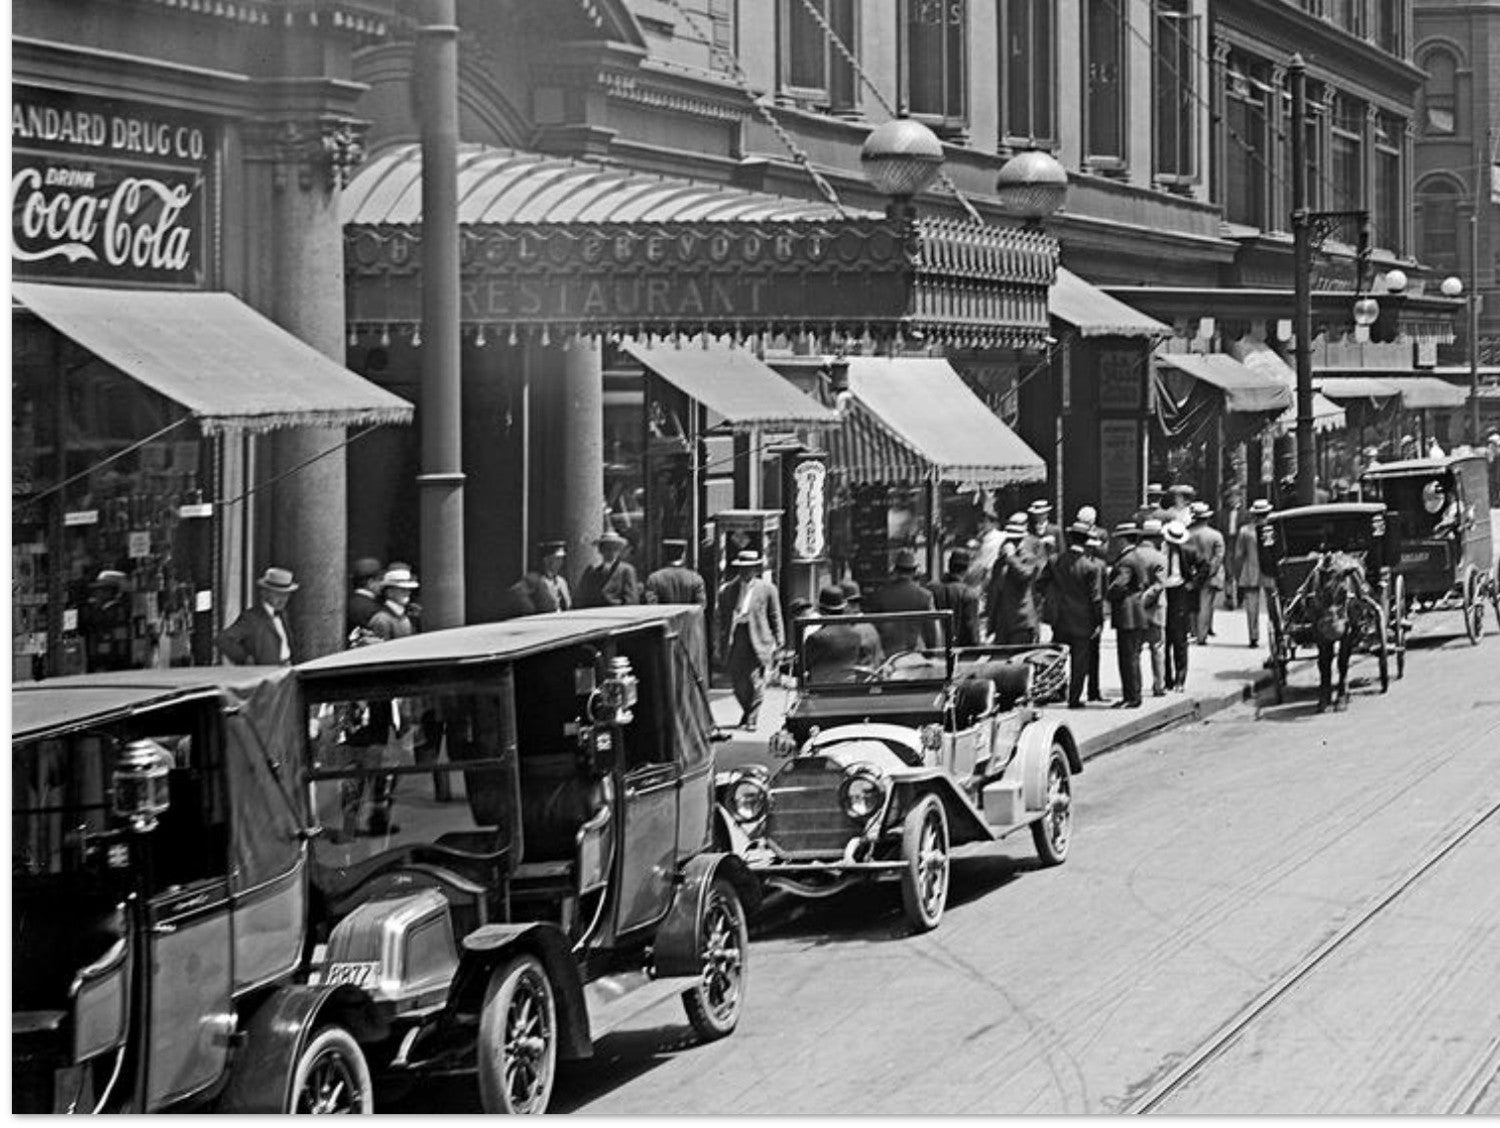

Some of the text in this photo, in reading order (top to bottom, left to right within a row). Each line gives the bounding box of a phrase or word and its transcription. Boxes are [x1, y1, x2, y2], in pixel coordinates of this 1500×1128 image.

[111, 117, 171, 155] DRUG
[175, 126, 207, 160] CO.
[46, 167, 97, 189] DRINK
[12, 167, 192, 270] Coca-Cola
